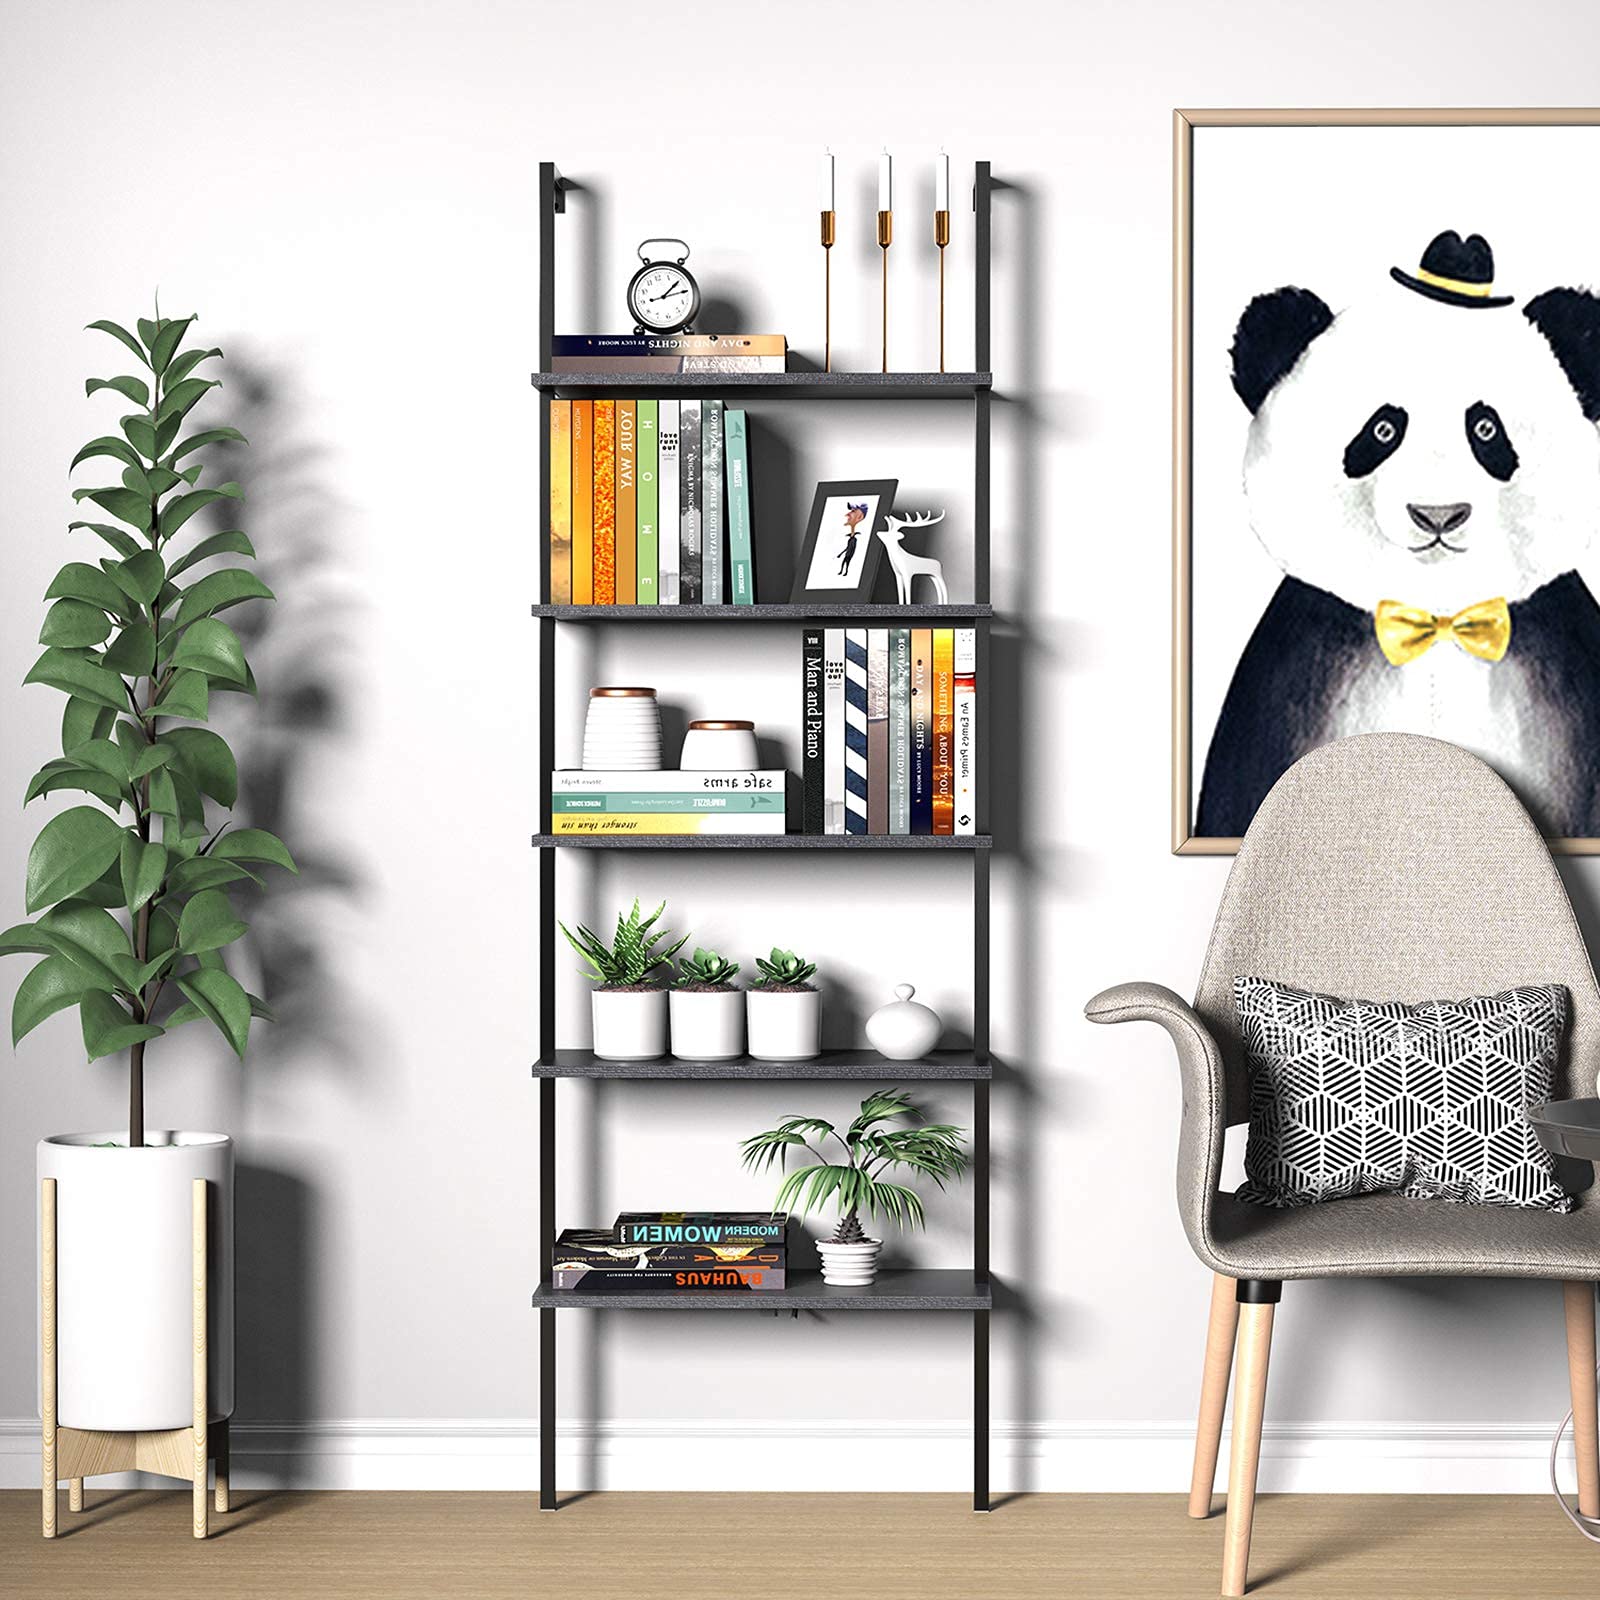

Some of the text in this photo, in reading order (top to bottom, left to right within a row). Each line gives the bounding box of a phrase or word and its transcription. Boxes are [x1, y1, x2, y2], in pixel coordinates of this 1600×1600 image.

[648, 339, 690, 348] NIGHTS
[720, 339, 744, 348] DAY
[660, 431, 678, 439] love
[687, 482, 694, 492] BY
[826, 660, 844, 668] love
[806, 657, 821, 688] Man
[916, 665, 924, 686] DAY
[806, 691, 822, 716] and
[916, 712, 924, 750] NIGHTS
[939, 671, 948, 795] SOMETHING ABOUT YOU
[806, 720, 821, 758] Piano
[561, 822, 575, 830] sin
[578, 822, 598, 831] than
[601, 819, 638, 830] stronger
[675, 1272, 763, 1285] BAUHAUS
